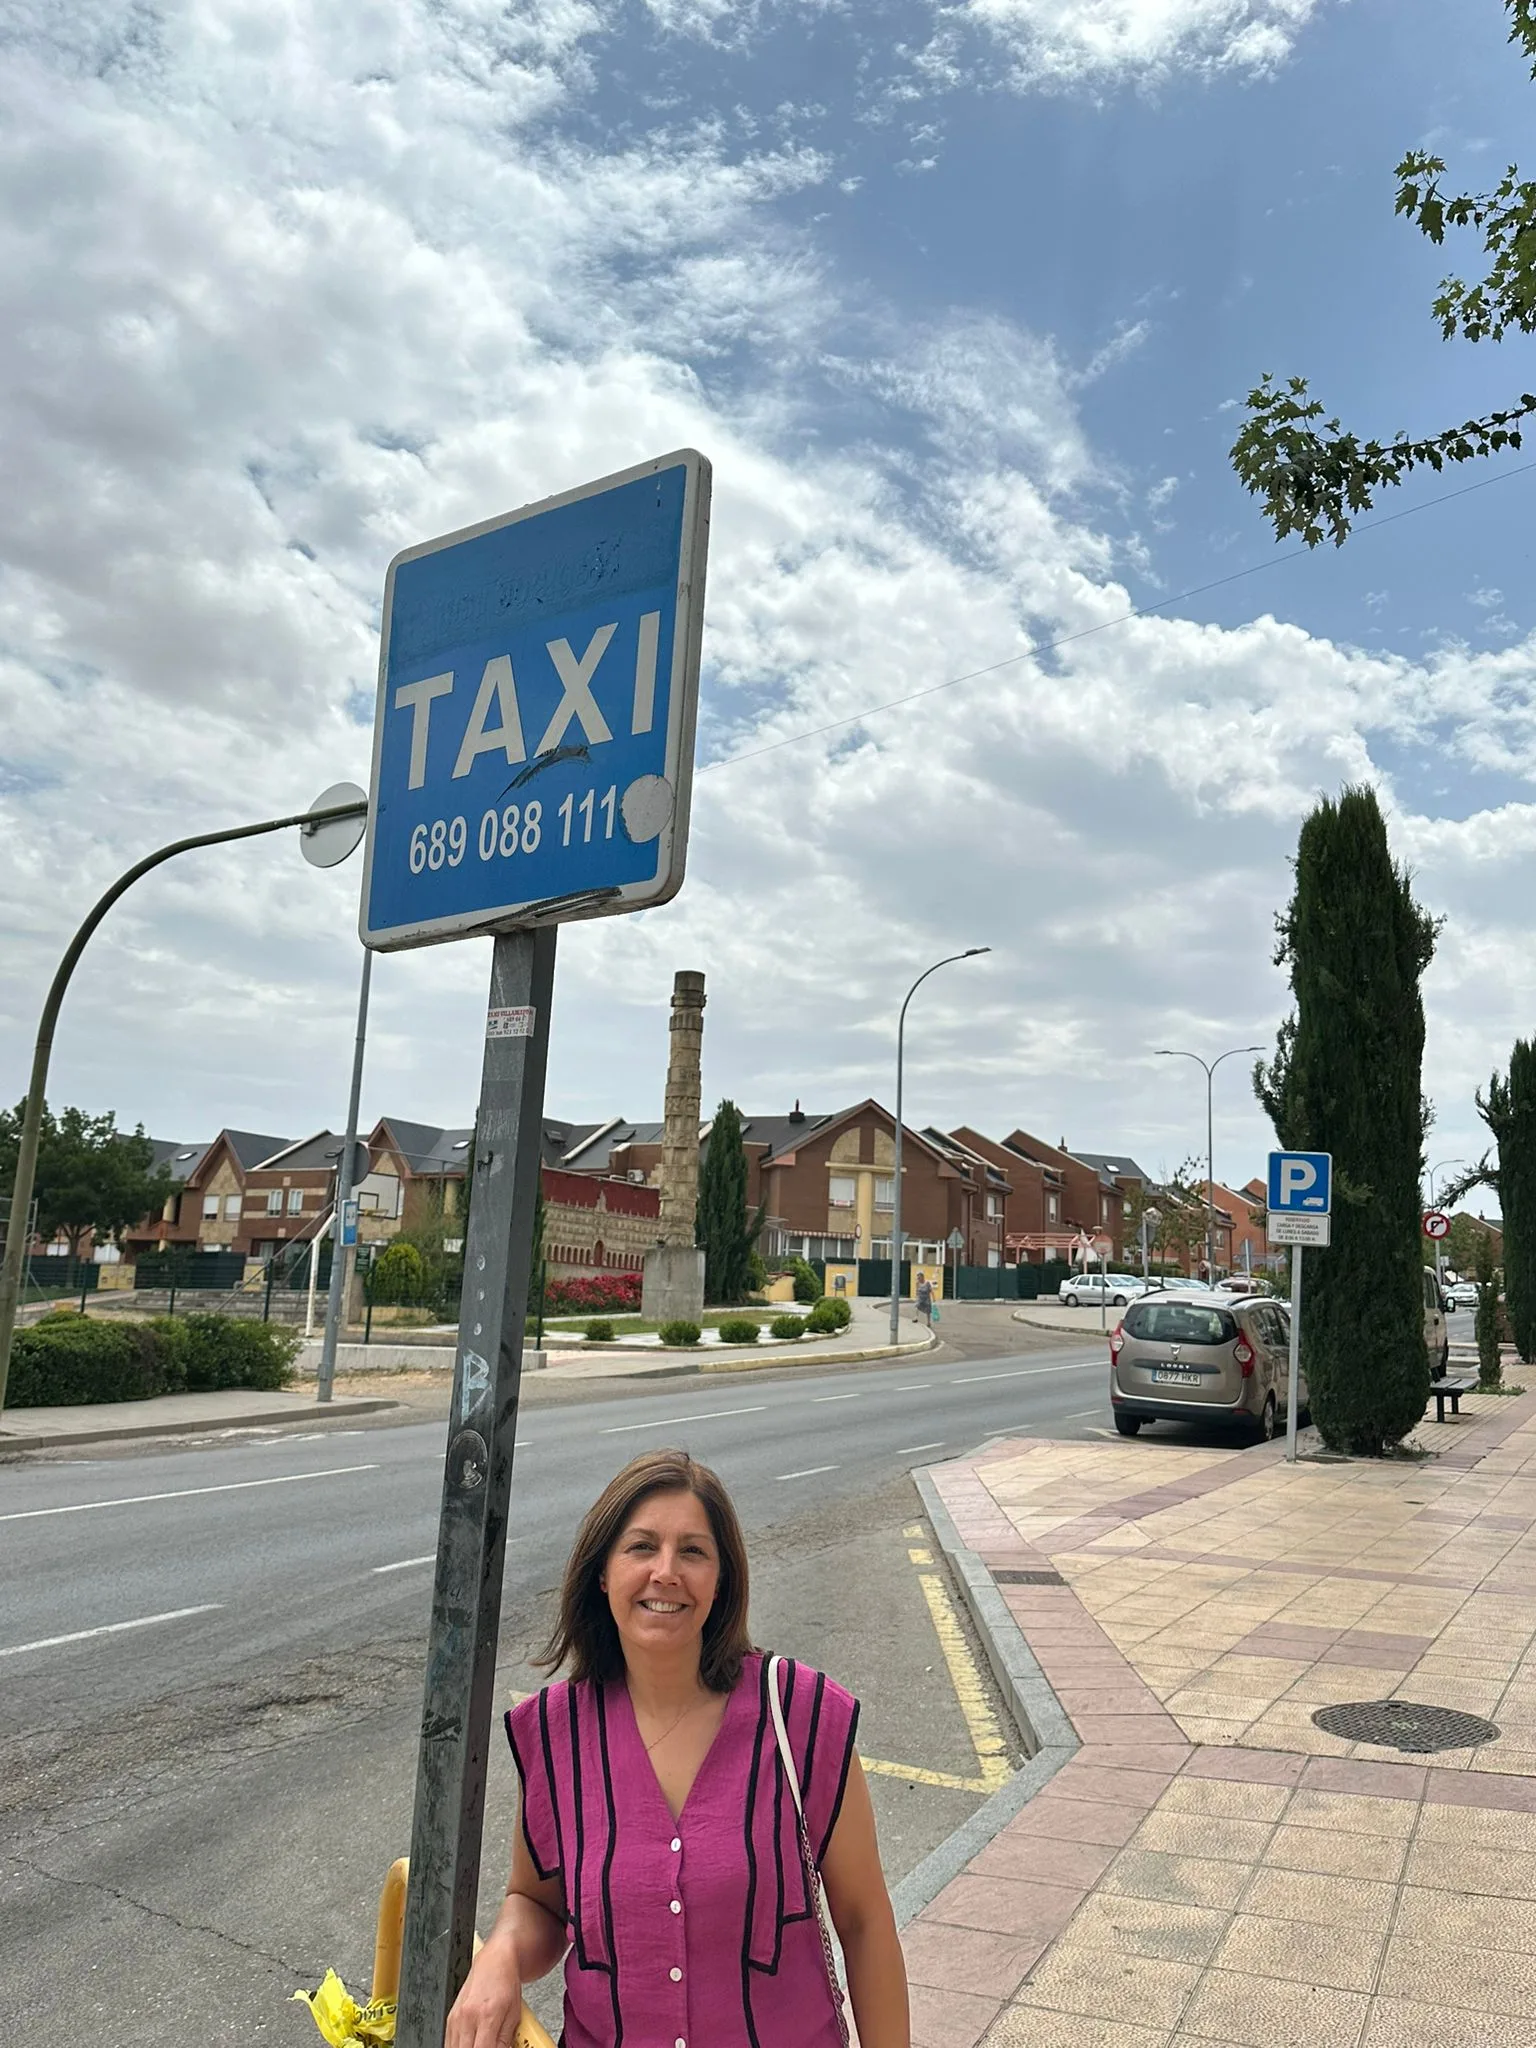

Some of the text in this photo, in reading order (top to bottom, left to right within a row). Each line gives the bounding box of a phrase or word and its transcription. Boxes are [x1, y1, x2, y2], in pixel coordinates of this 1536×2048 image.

[395, 610, 660, 790] TAXI
[409, 784, 617, 874] 689 088 111
[1280, 1159, 1317, 1205] P
[1158, 1371, 1199, 1383] 0877 HKR
